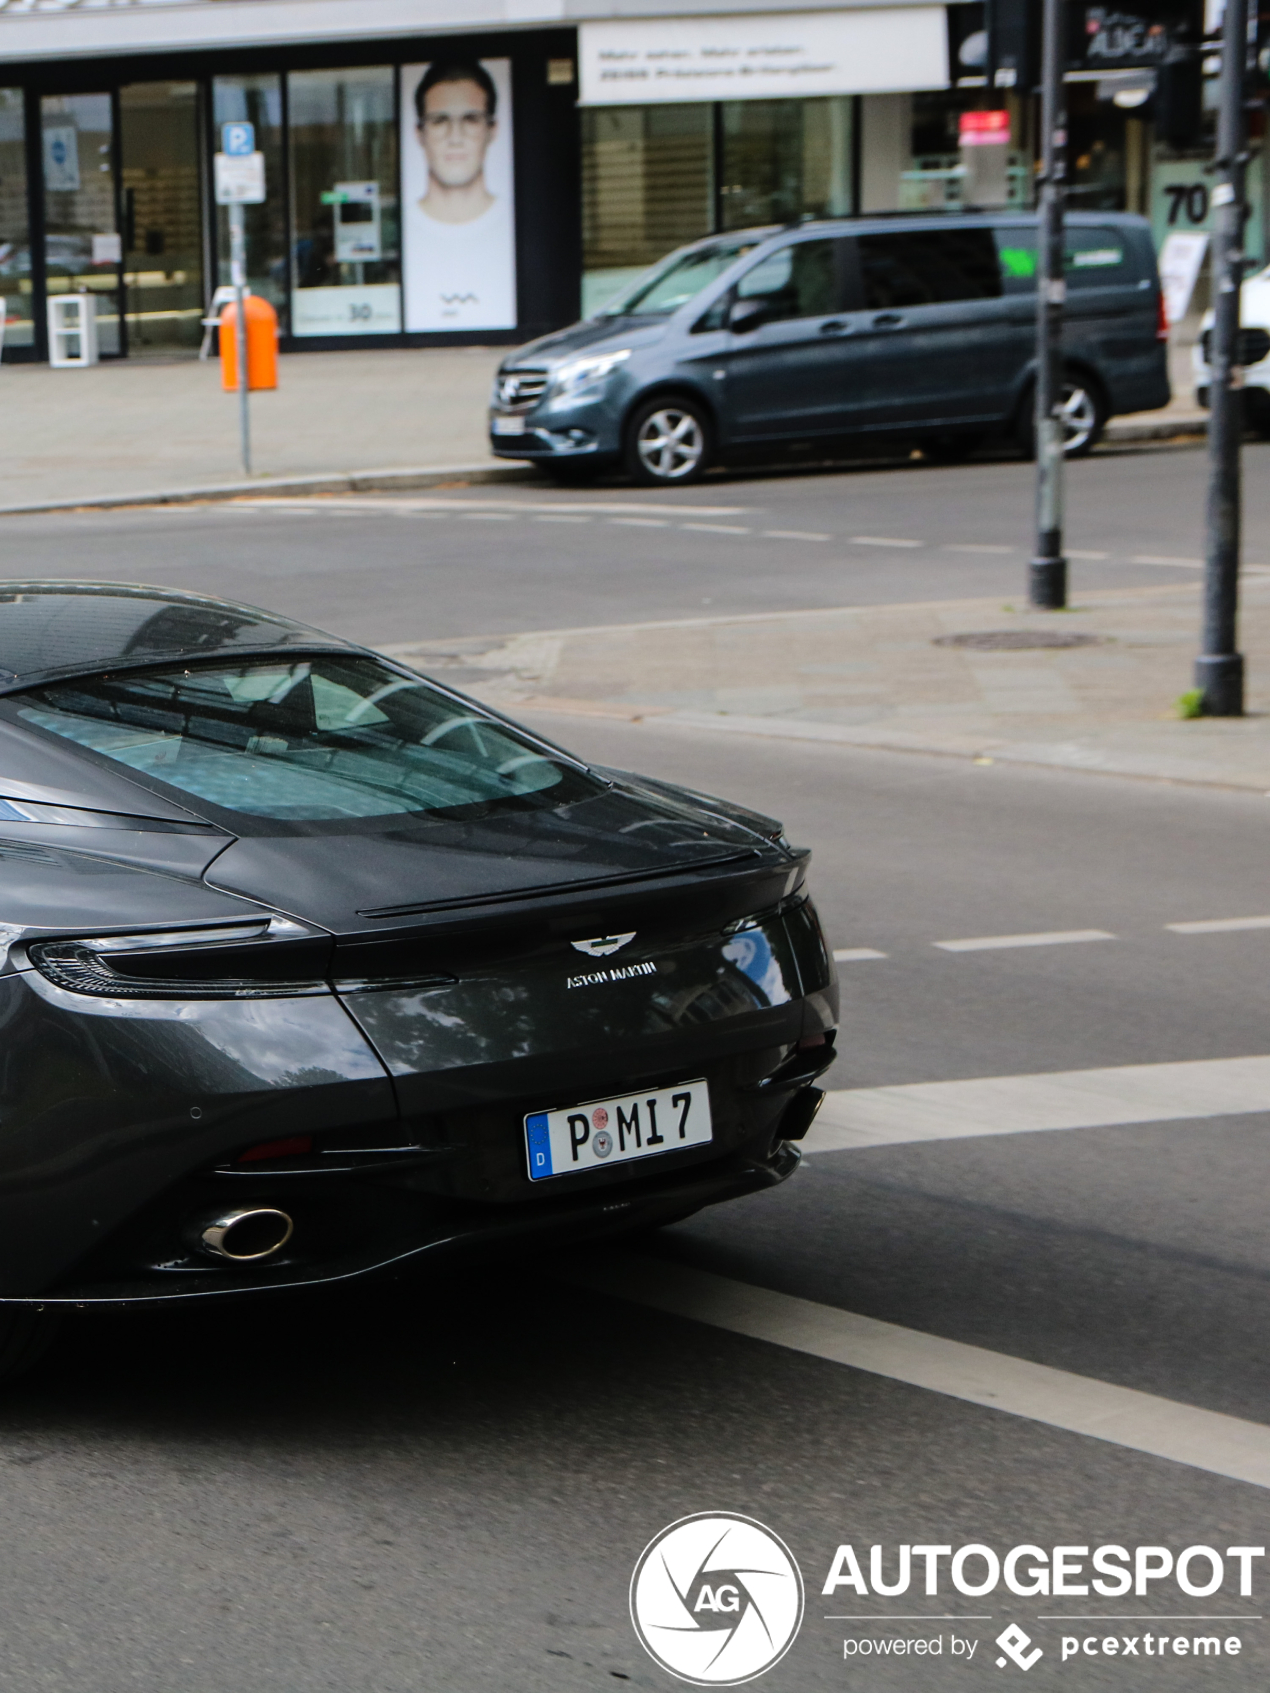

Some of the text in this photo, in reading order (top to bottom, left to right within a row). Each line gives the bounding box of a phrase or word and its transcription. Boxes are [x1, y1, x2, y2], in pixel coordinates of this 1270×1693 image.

[1164, 183, 1209, 226] 70
[567, 961, 658, 989] ASTON MARTIN
[567, 1091, 692, 1161] P MI 7
[536, 1152, 545, 1166] D
